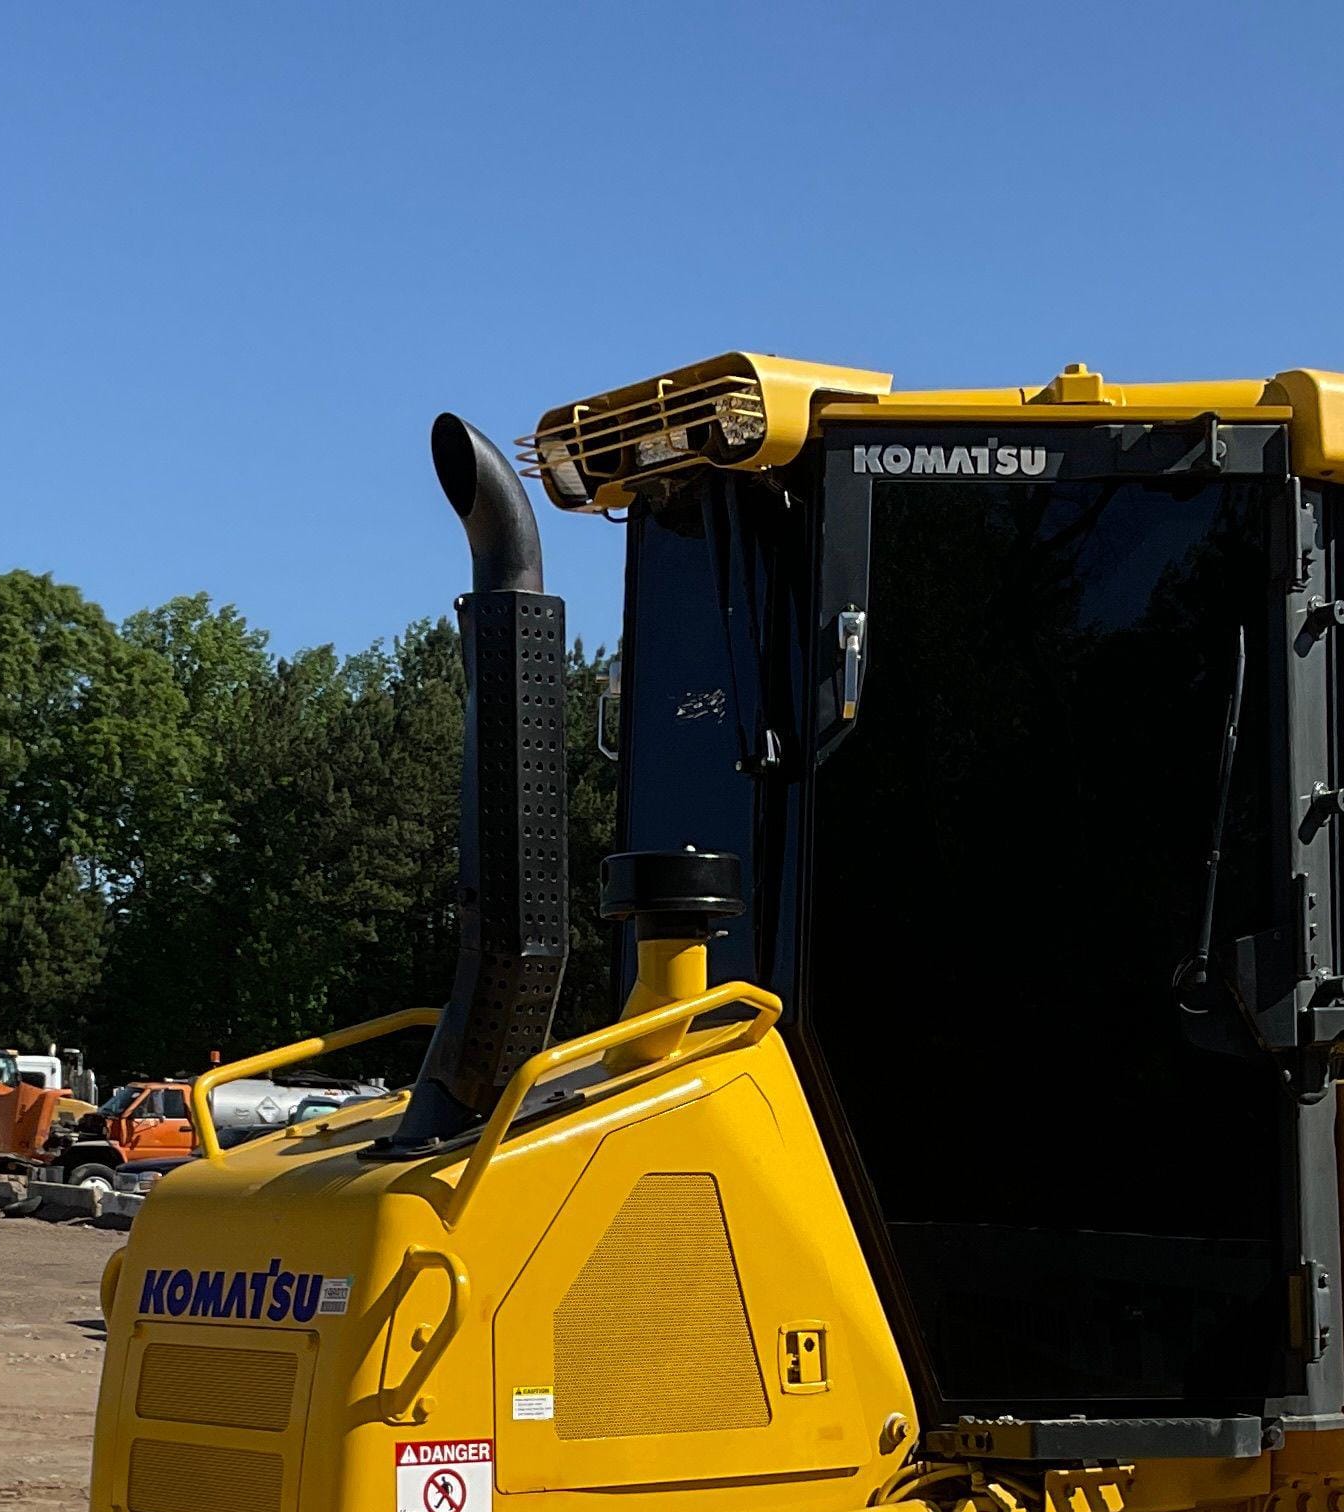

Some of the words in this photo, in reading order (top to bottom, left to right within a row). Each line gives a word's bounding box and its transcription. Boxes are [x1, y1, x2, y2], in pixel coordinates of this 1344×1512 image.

[853, 437, 1047, 476] KOMATSU
[138, 1258, 324, 1323] KOMATSU
[420, 1443, 491, 1463] DANGER
